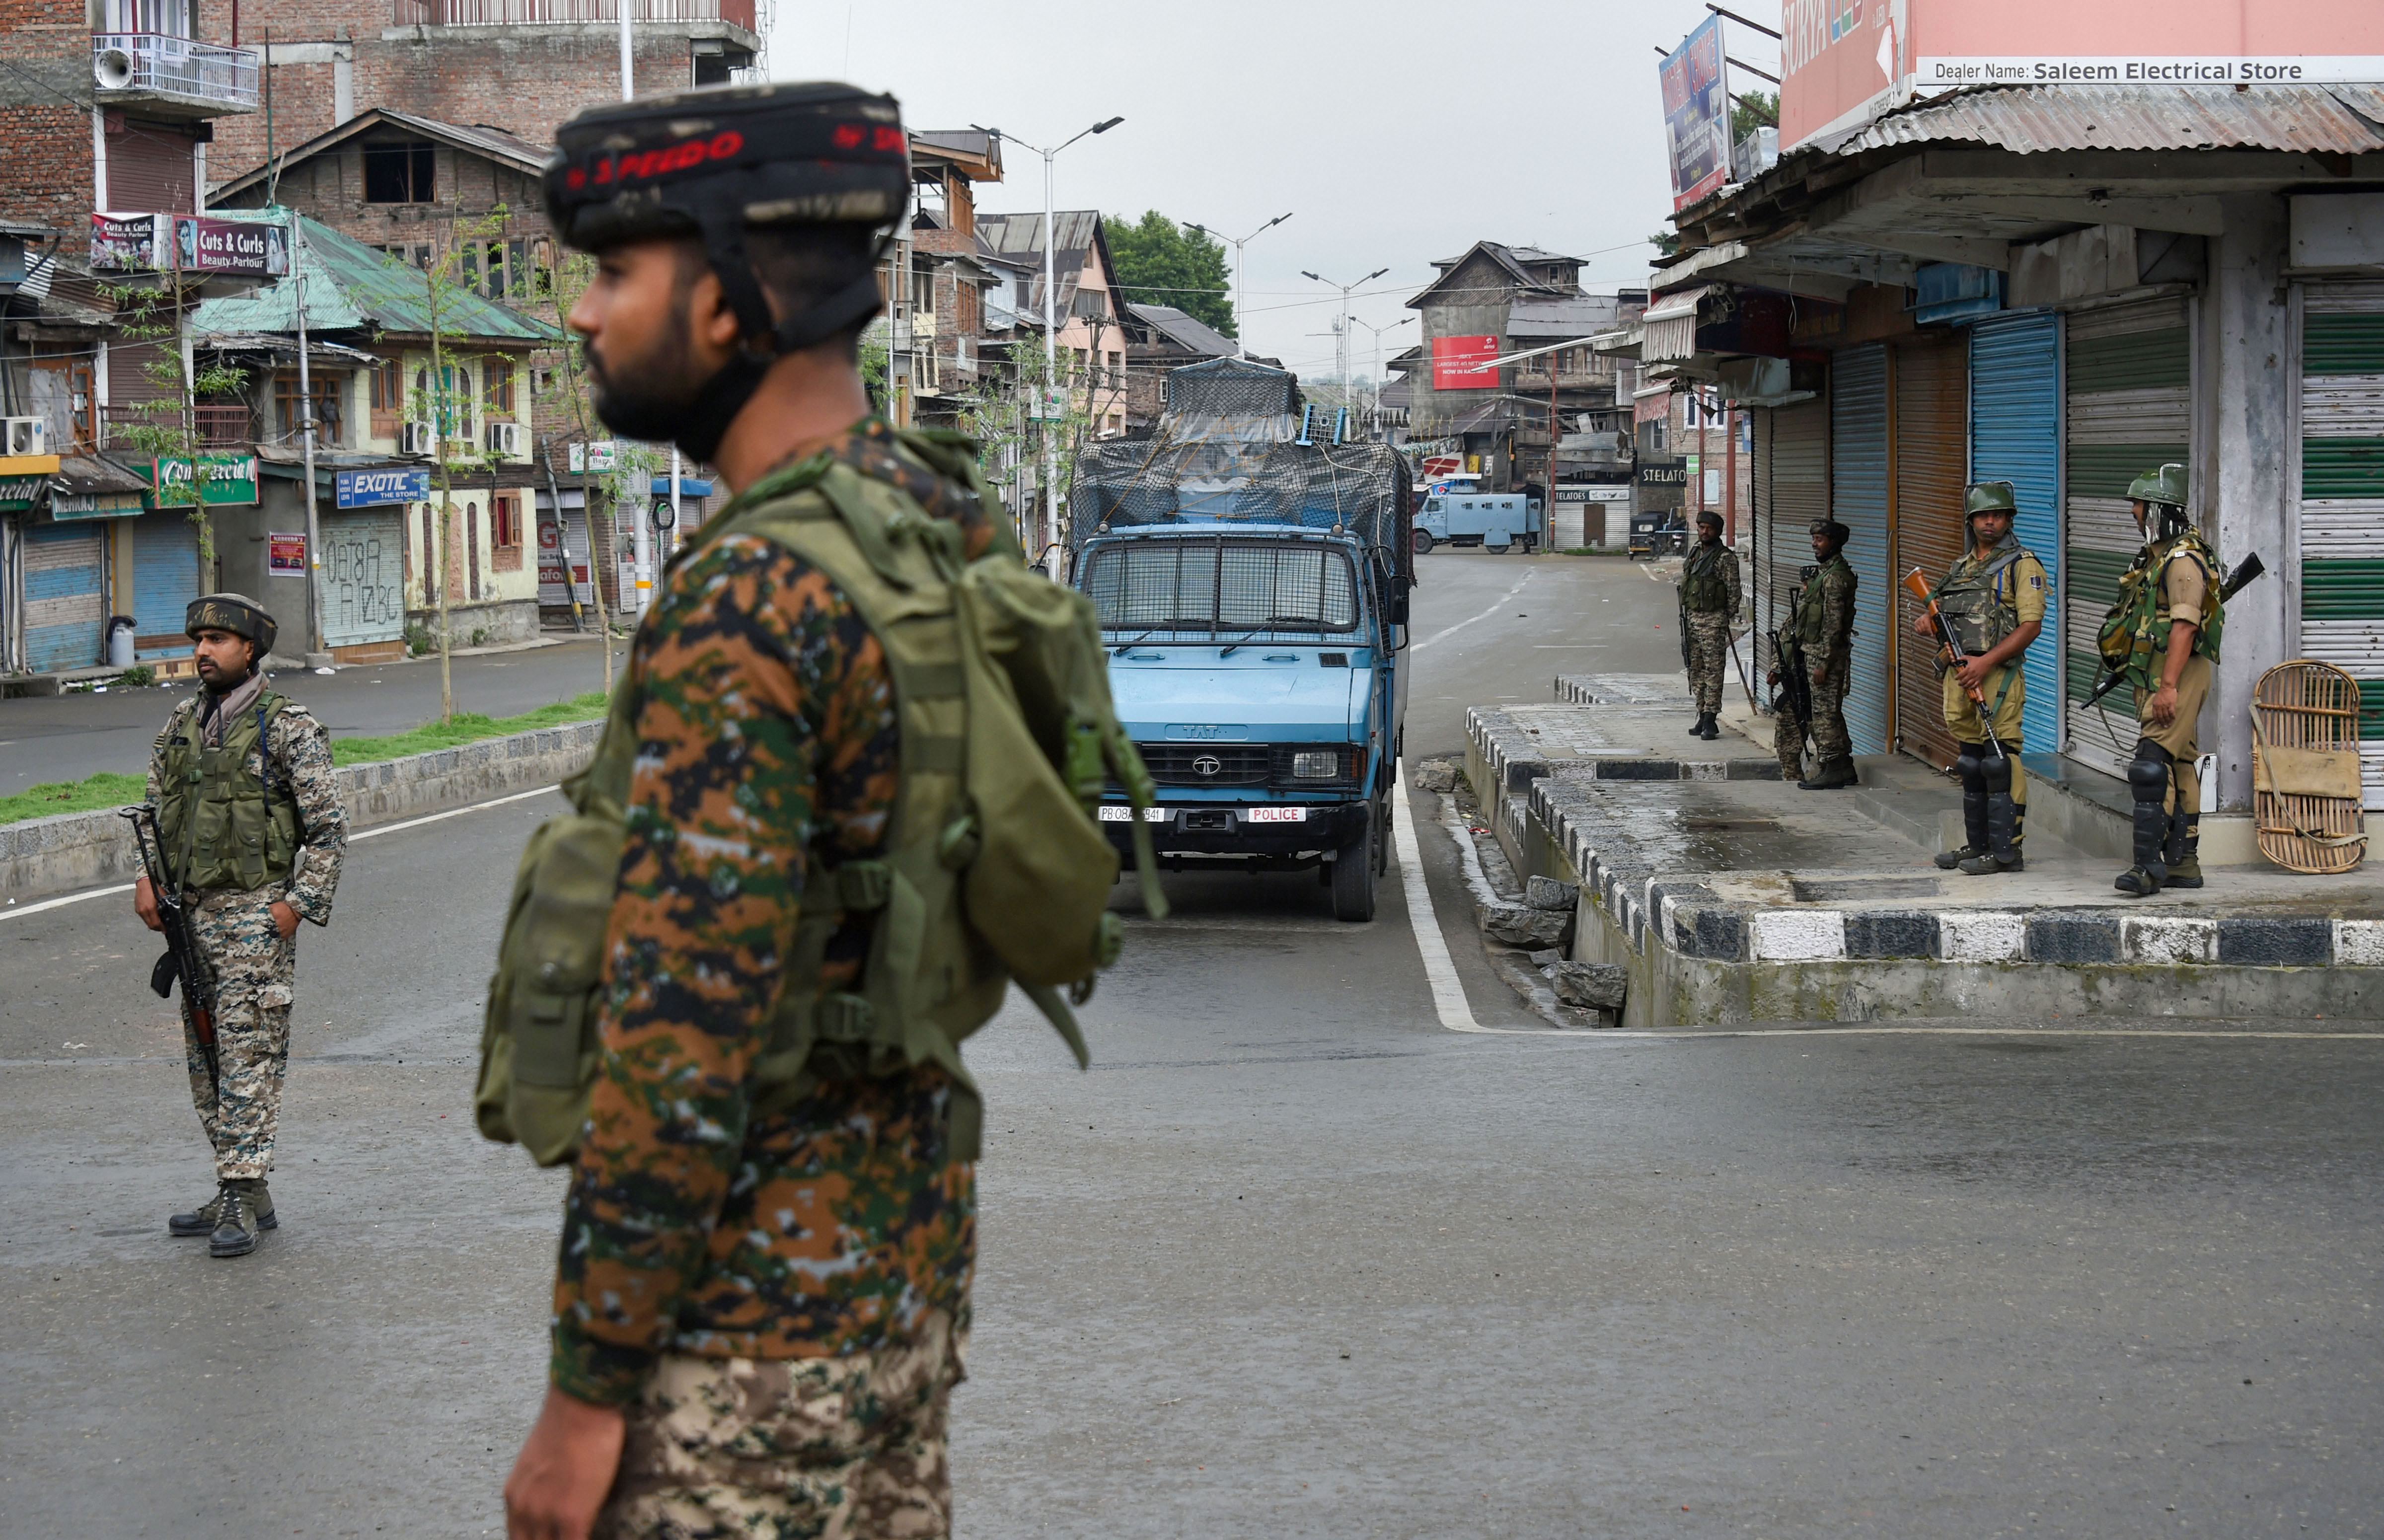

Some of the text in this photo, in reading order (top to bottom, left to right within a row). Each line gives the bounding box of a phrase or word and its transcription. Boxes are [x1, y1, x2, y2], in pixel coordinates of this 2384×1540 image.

[1781, 0, 1827, 82] SURYA
[1936, 62, 2302, 79] Dealer Name: Saleem Electrical Store
[104, 221, 123, 231] Cuts
[133, 222, 151, 231] Curls
[200, 230, 264, 254] Cuts & Curls
[202, 254, 264, 268] Beauty Parlour
[1643, 469, 1686, 482] STELATO
[354, 473, 409, 494] EXOTIC
[1555, 492, 1586, 500] TELATOES
[55, 496, 95, 513] MEHRAJ
[1254, 809, 1298, 821] POLICE
